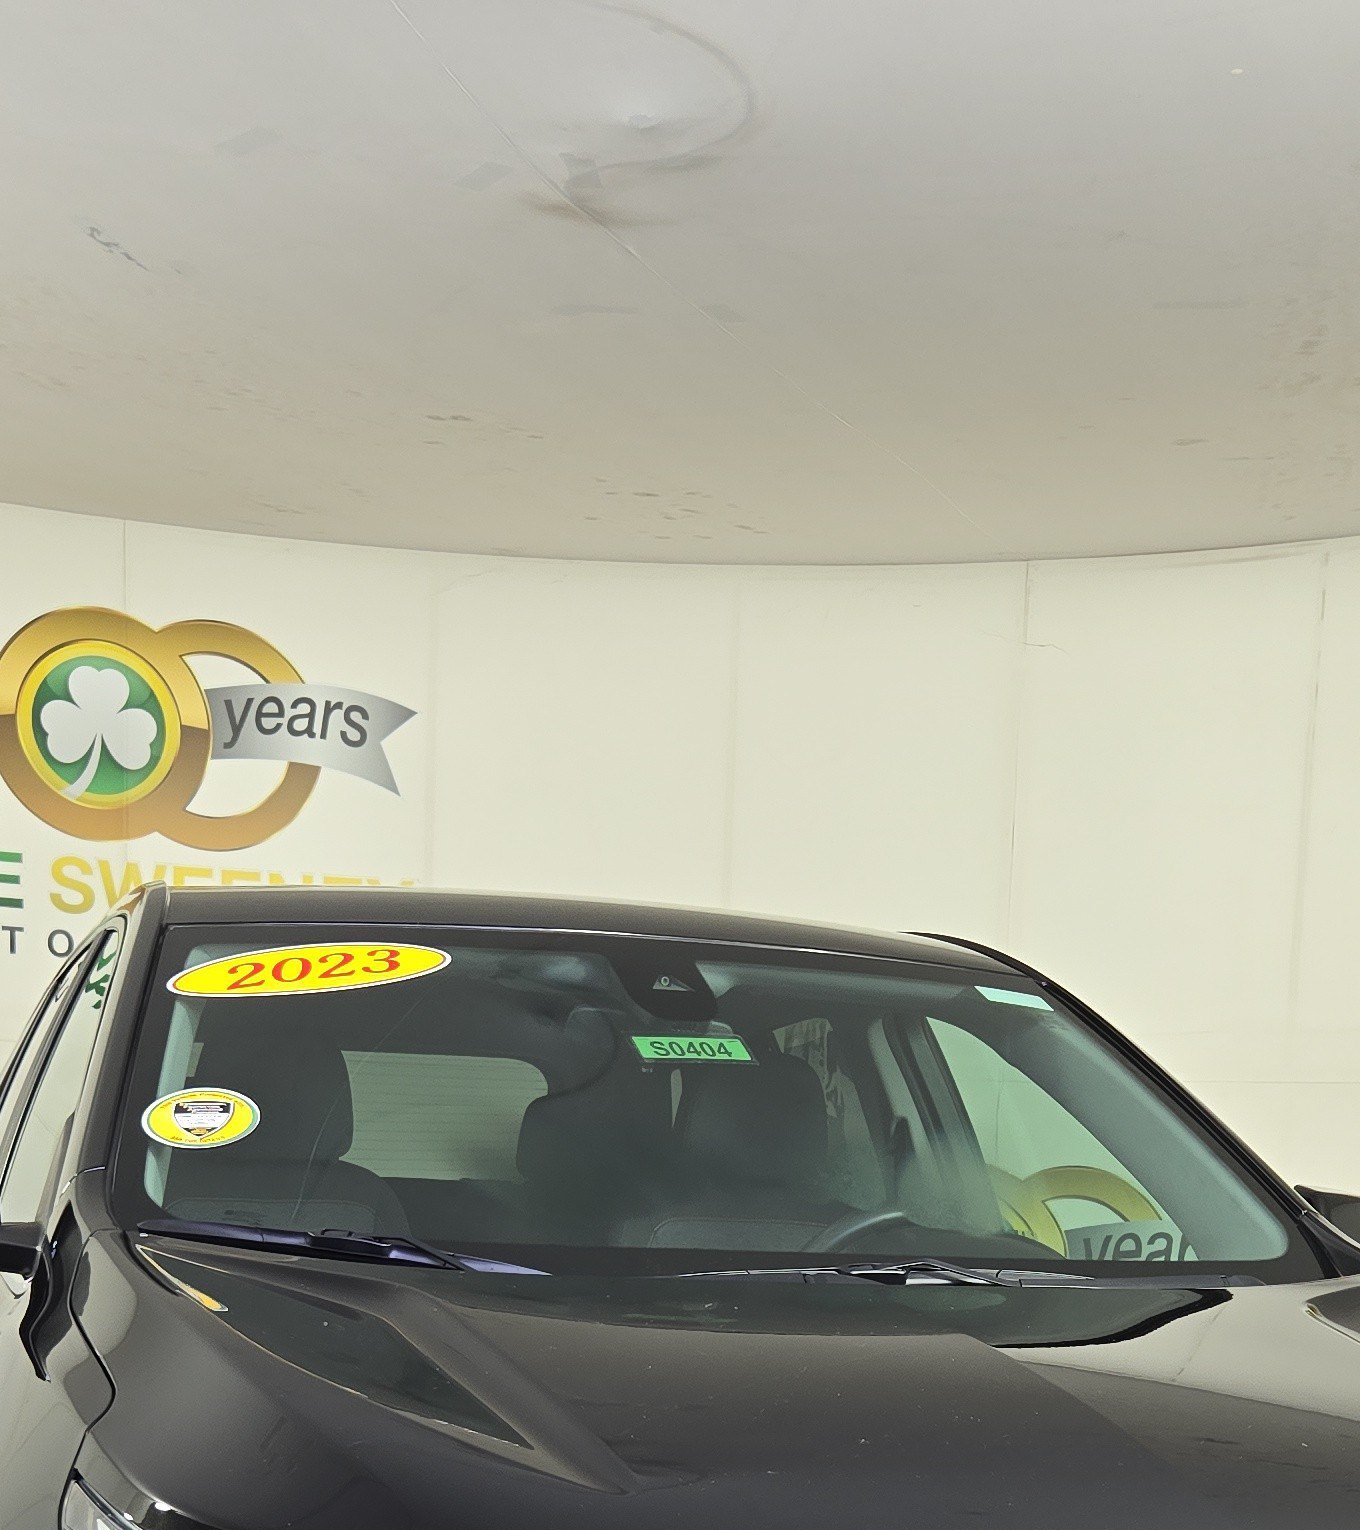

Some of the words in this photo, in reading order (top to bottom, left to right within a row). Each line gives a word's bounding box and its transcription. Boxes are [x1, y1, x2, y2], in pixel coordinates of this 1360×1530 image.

[222, 694, 369, 749] years
[227, 949, 401, 990] 2023
[649, 1041, 732, 1058] S0404
